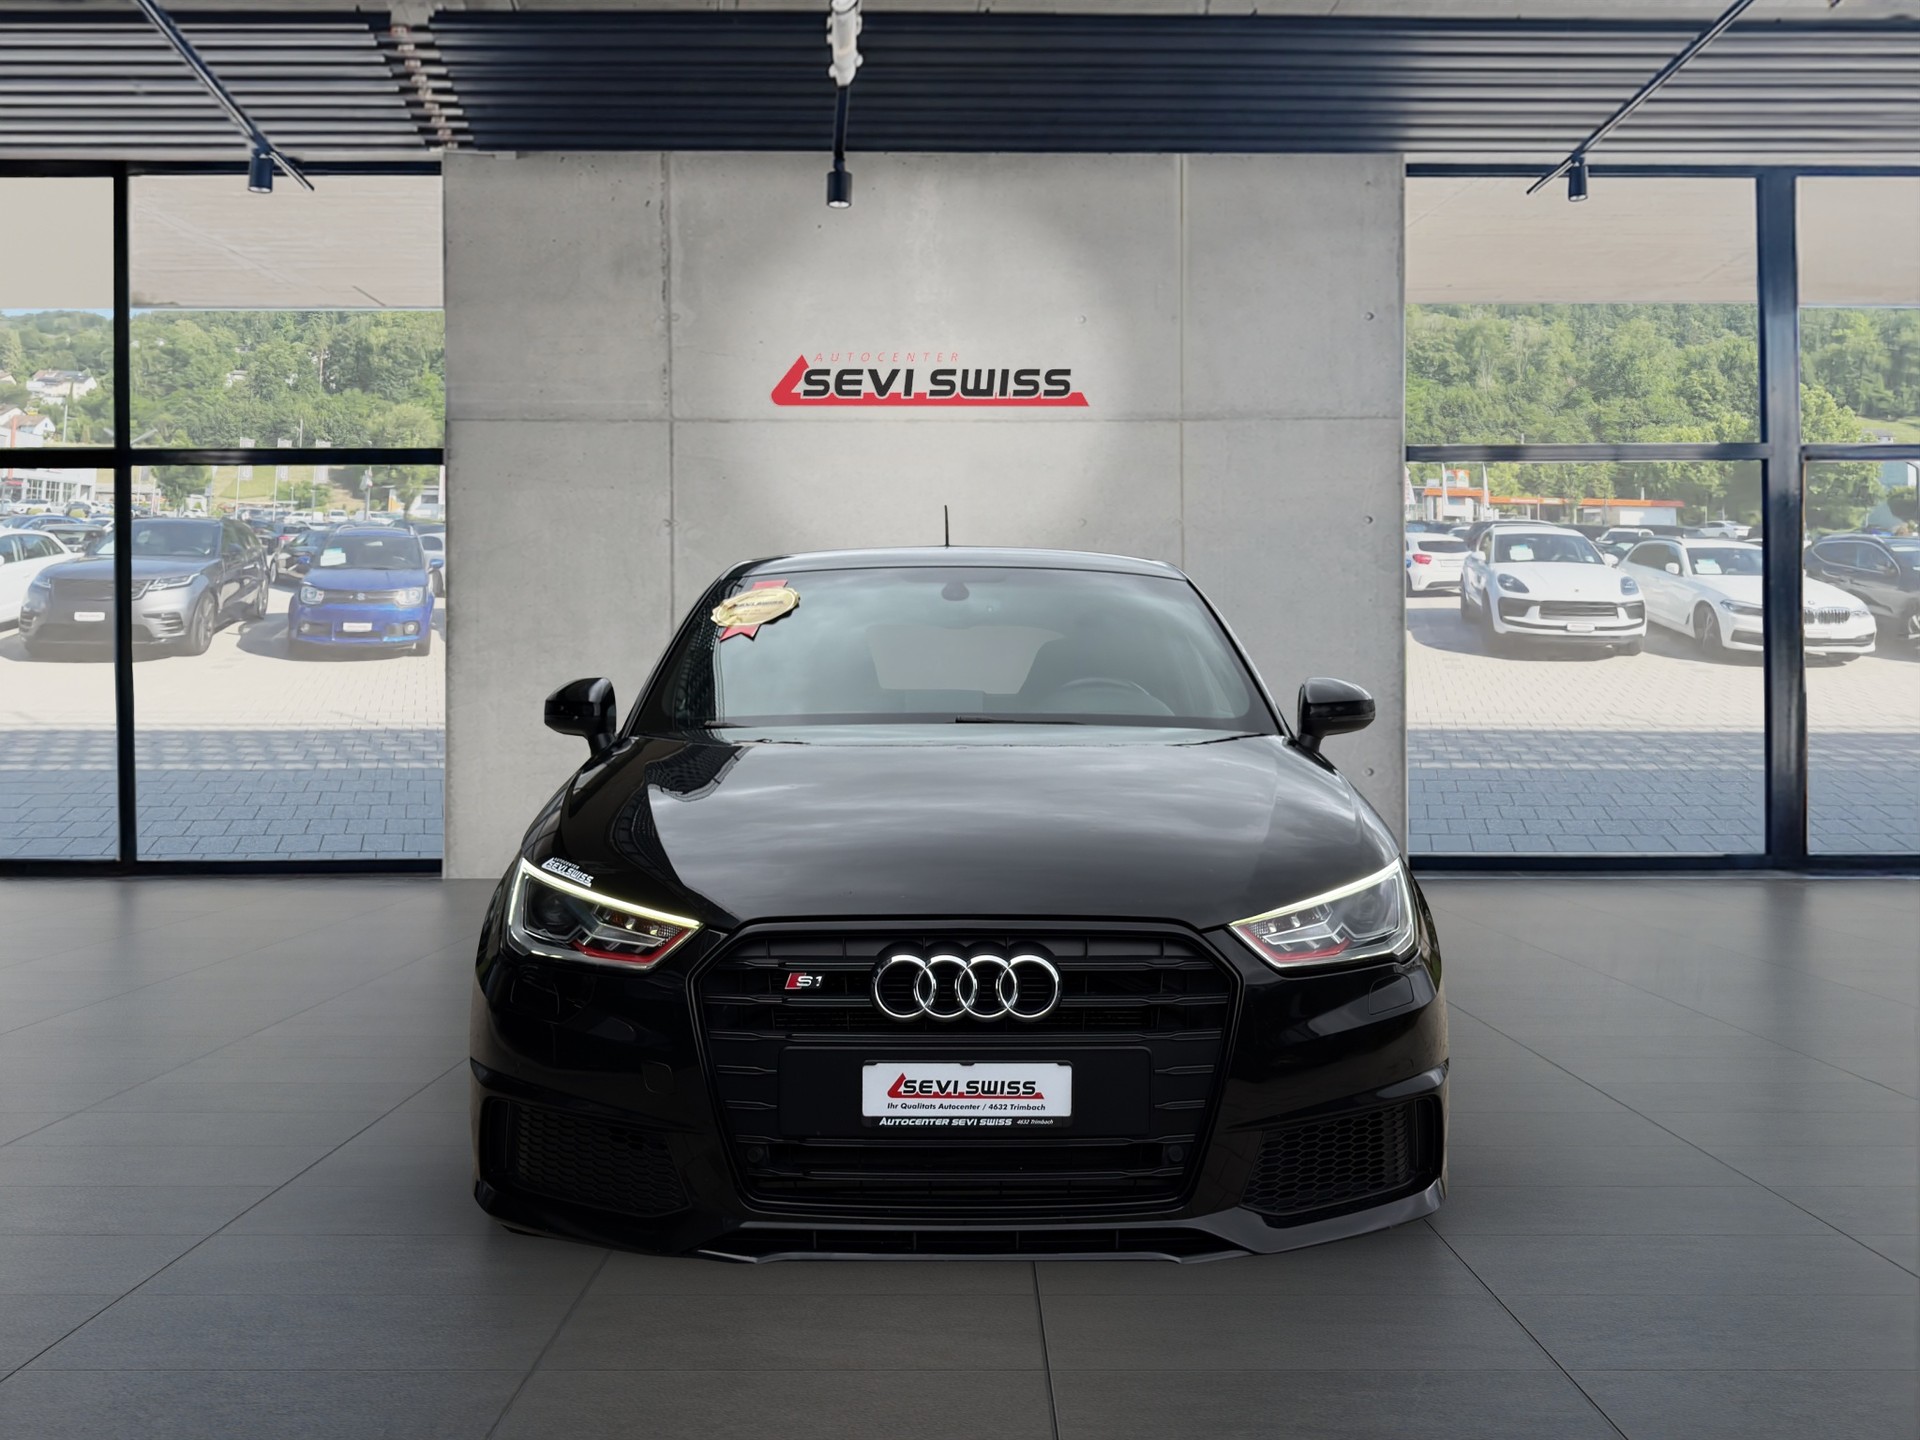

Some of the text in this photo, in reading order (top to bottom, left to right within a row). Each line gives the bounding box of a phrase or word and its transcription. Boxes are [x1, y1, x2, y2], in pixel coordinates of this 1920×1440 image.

[813, 352, 959, 362] AUTOCENTER
[802, 368, 1072, 398] SEVI SWISS
[546, 860, 594, 884] SEVI SWISS
[796, 975, 823, 987] S1
[902, 1079, 1036, 1096] SEVI SWISS
[887, 1102, 899, 1110] Ihr
[988, 1103, 1008, 1111] 4632
[1010, 1103, 1046, 1111] Trimbach
[951, 1118, 978, 1126] SEVI
[979, 1118, 1013, 1126] SWISS
